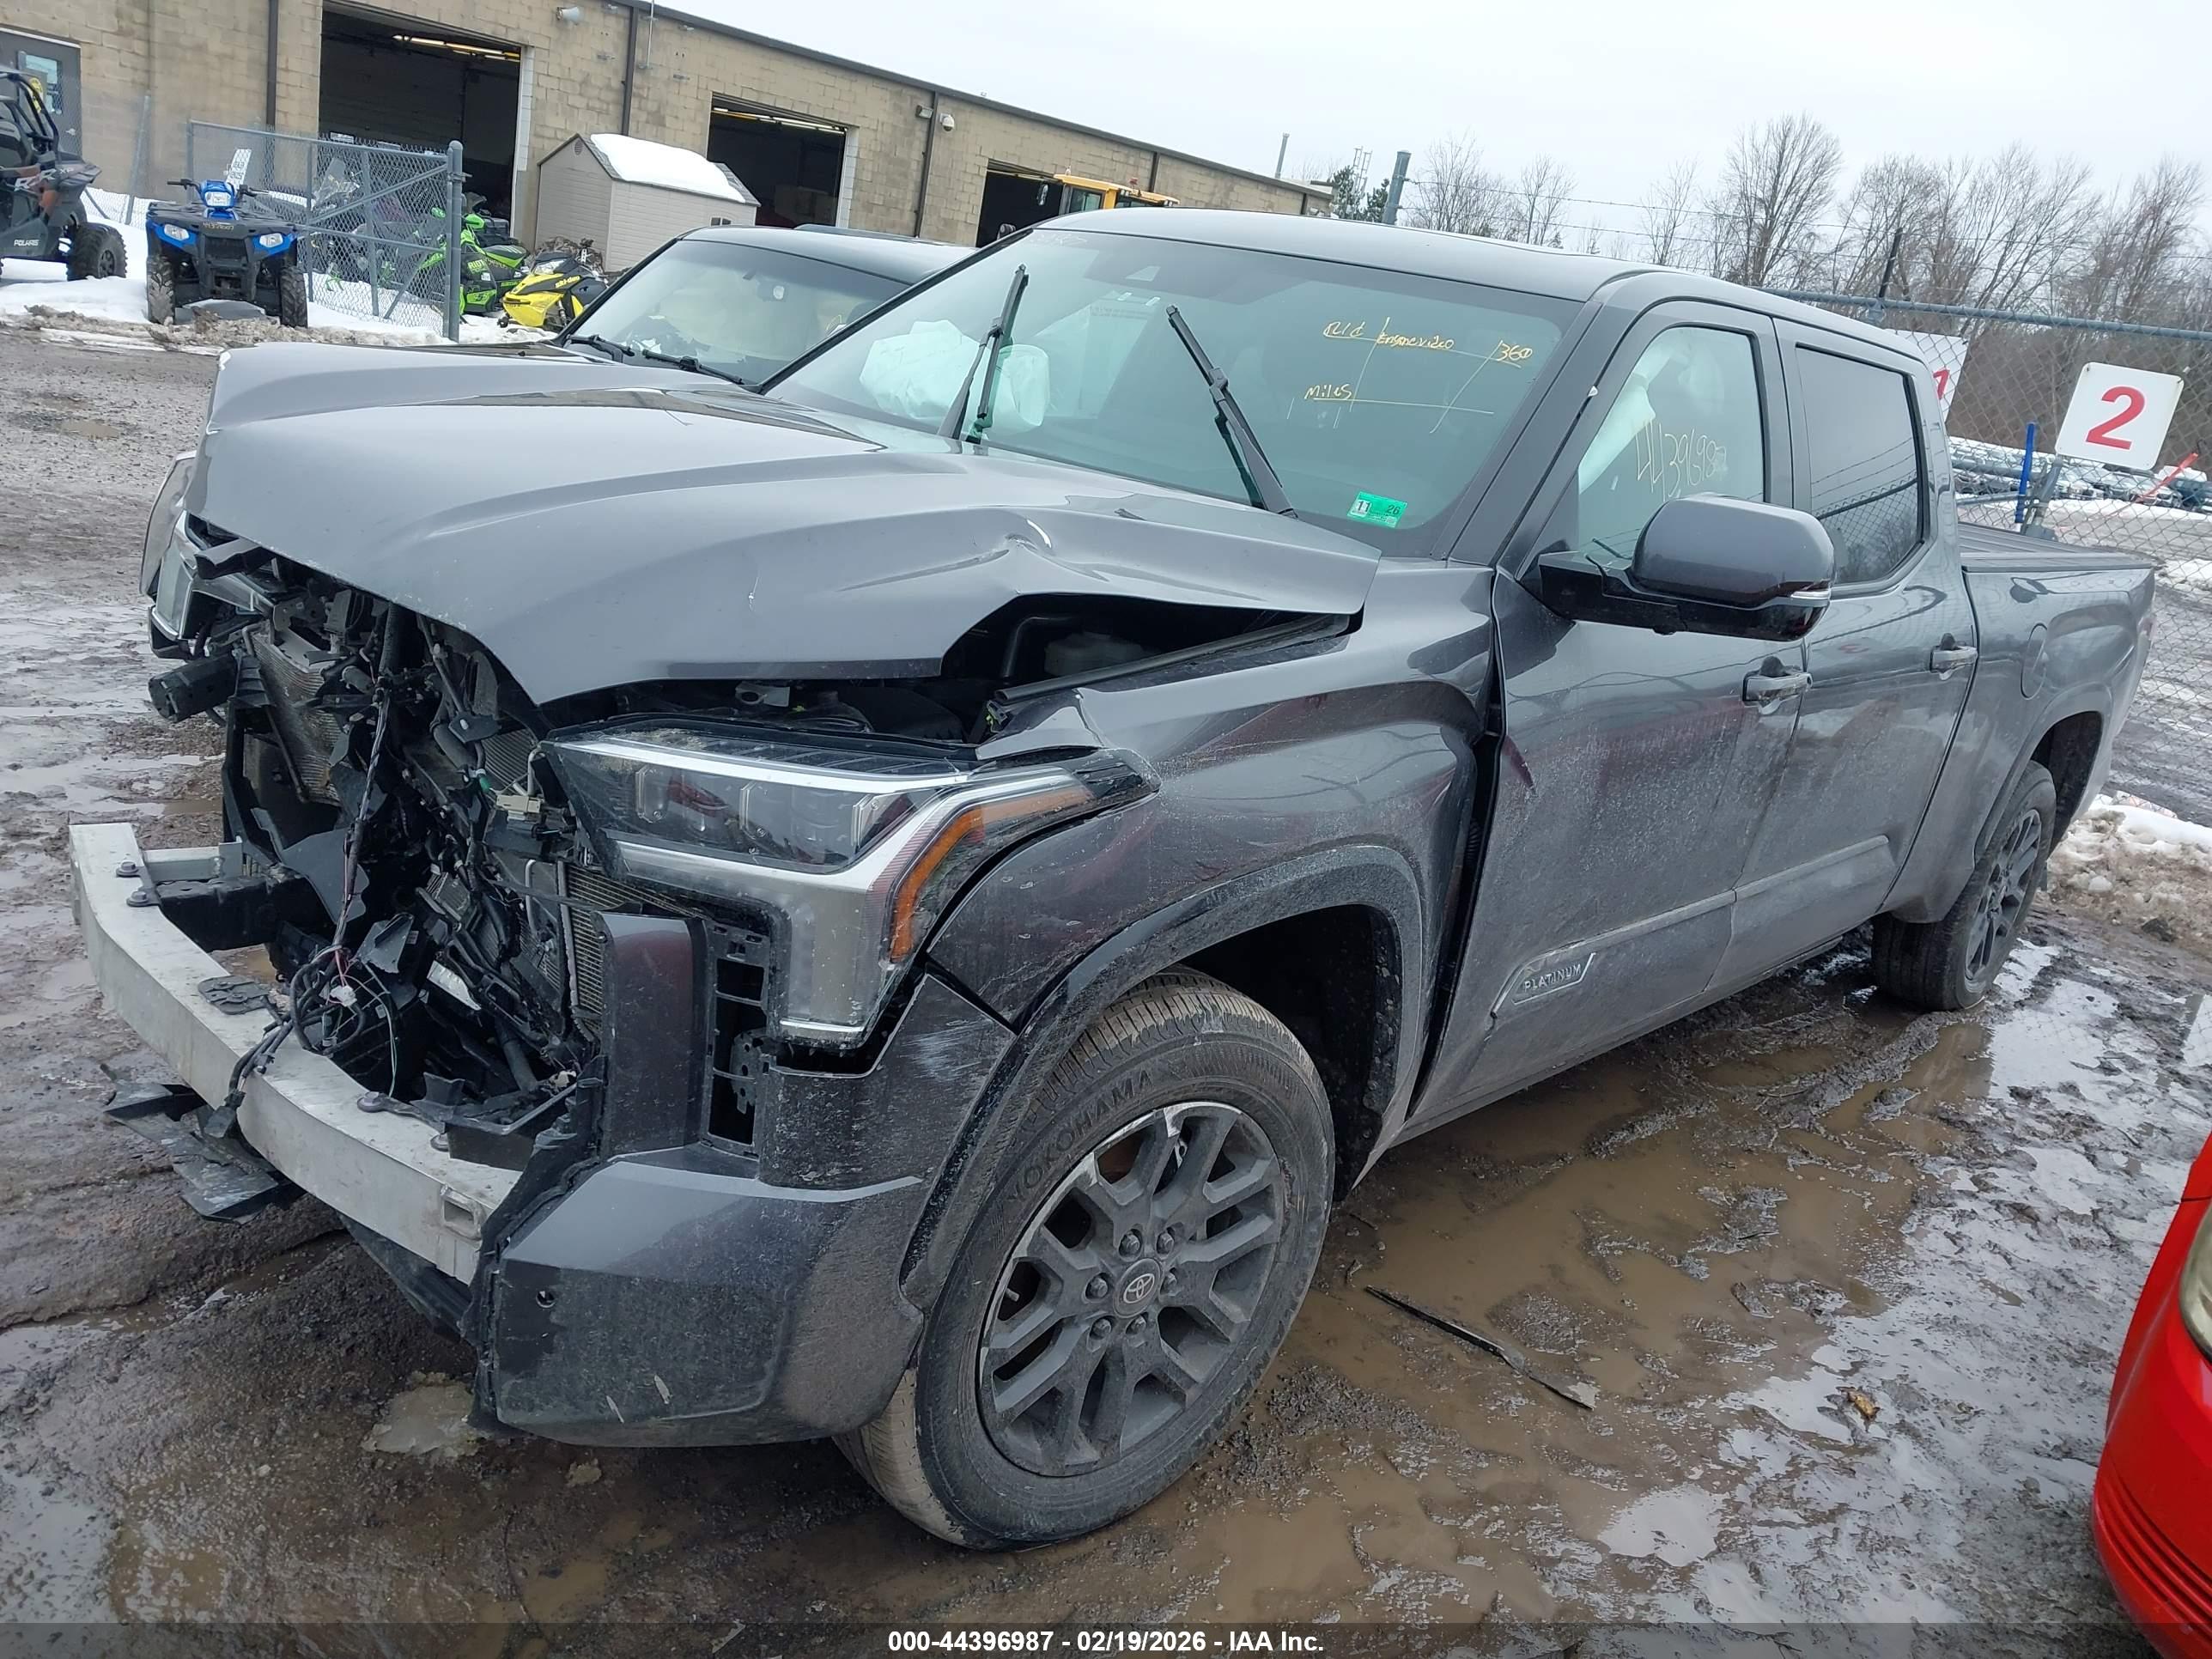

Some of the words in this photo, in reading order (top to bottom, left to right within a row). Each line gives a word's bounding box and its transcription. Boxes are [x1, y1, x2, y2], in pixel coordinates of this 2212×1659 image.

[1933, 368, 1950, 399] 1
[2086, 386, 2146, 450] 2
[1358, 501, 1371, 513] 11
[1386, 504, 1401, 515] 26
[1523, 963, 1582, 992] PLATINUM
[1006, 1070, 1154, 1202] YOKOHAMA
